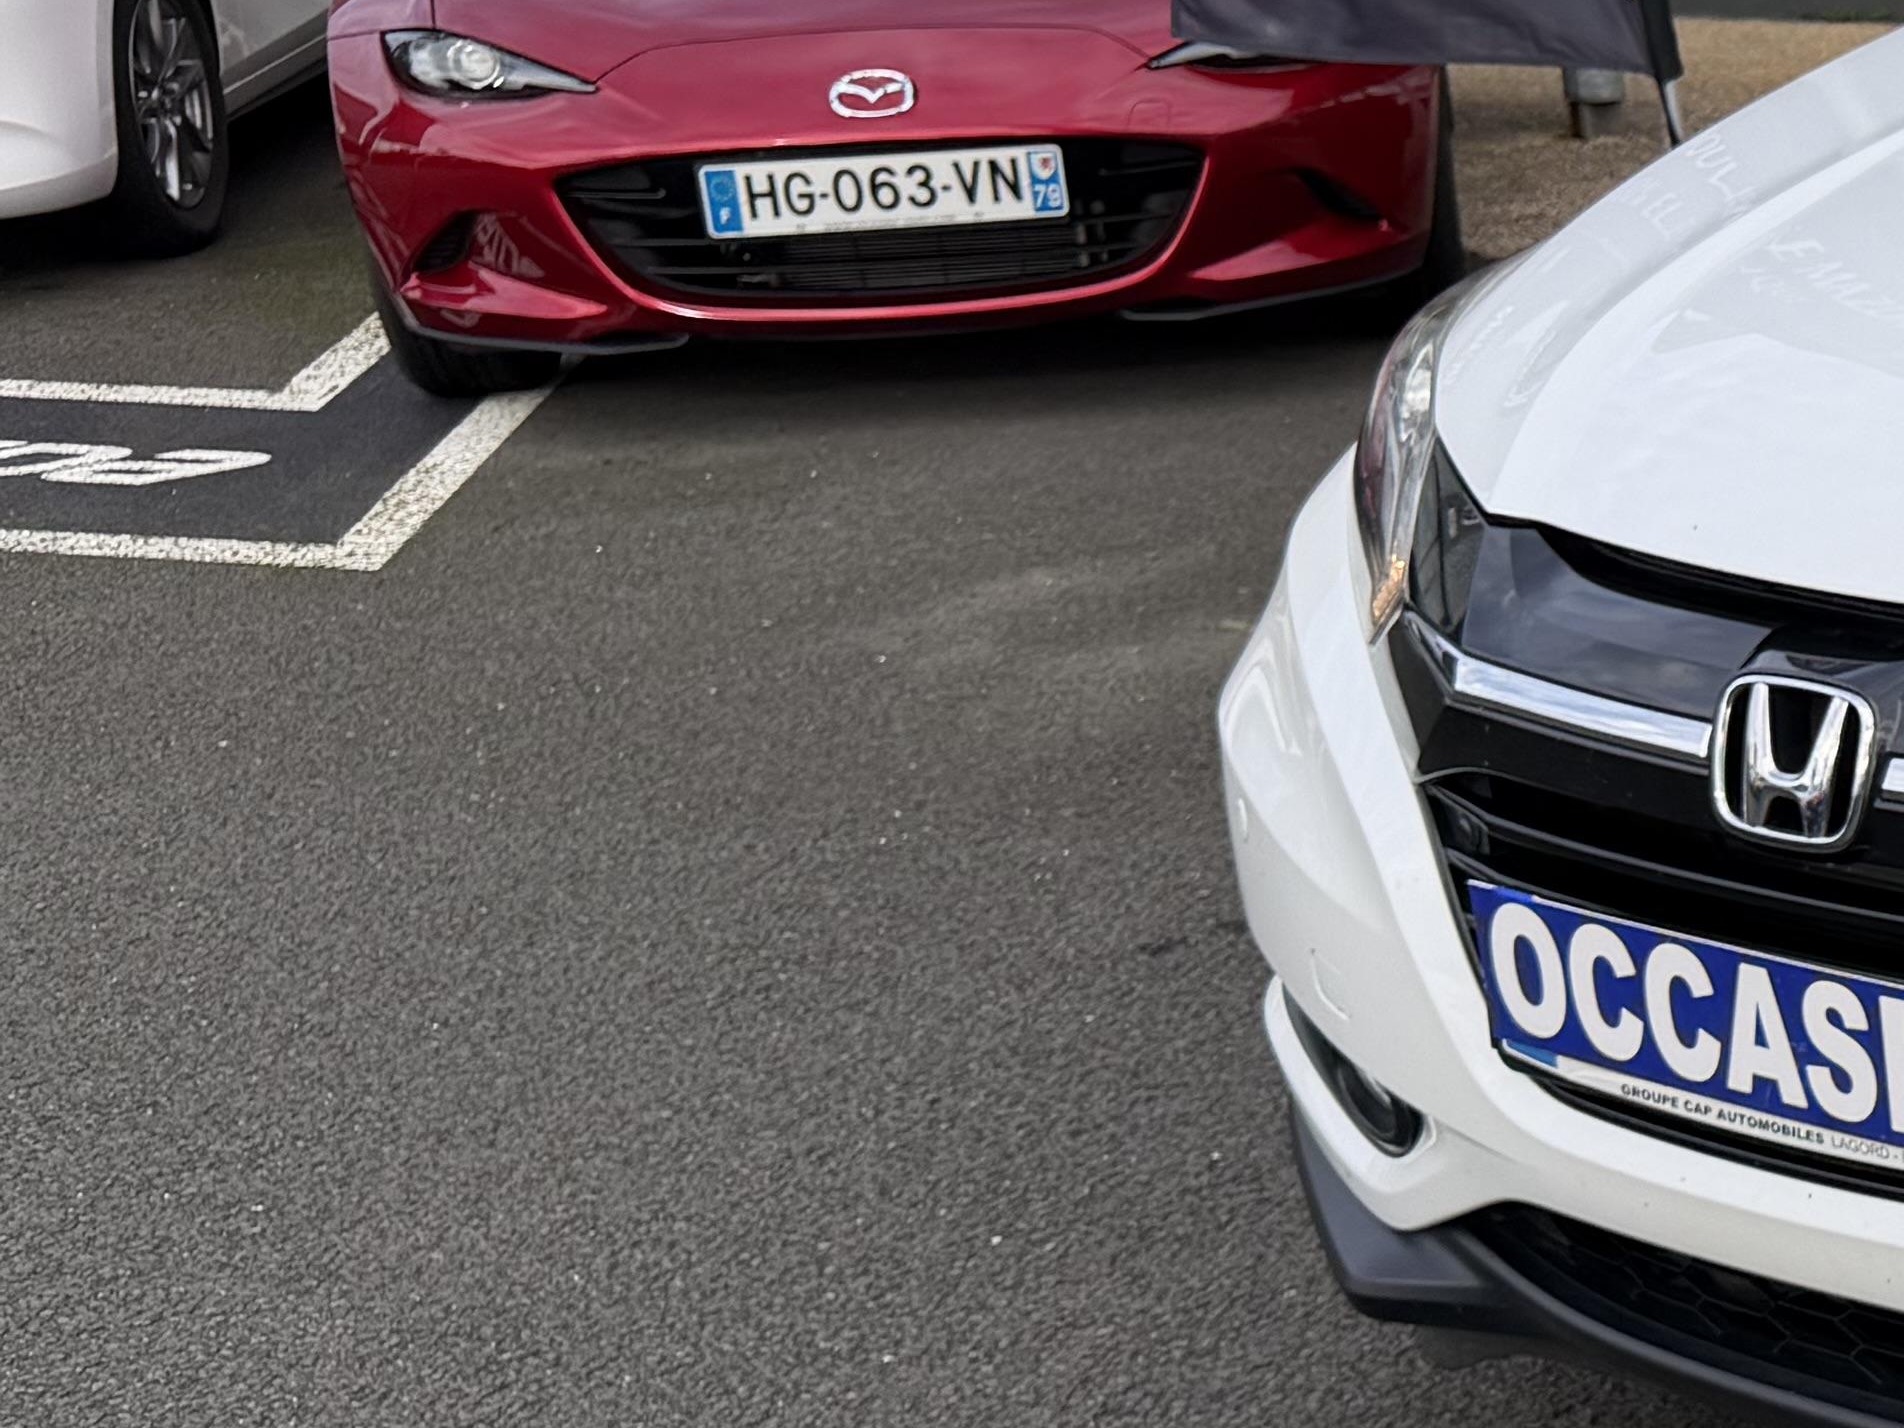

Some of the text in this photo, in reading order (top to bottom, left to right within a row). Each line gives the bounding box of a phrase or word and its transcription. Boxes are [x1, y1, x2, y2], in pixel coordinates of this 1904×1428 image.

[744, 157, 1024, 221] HG-063-VN
[1620, 1083, 1680, 1110] GROUPE
[1683, 1098, 1713, 1118] CAP
[1717, 1106, 1826, 1145] AUTOMOBILES
